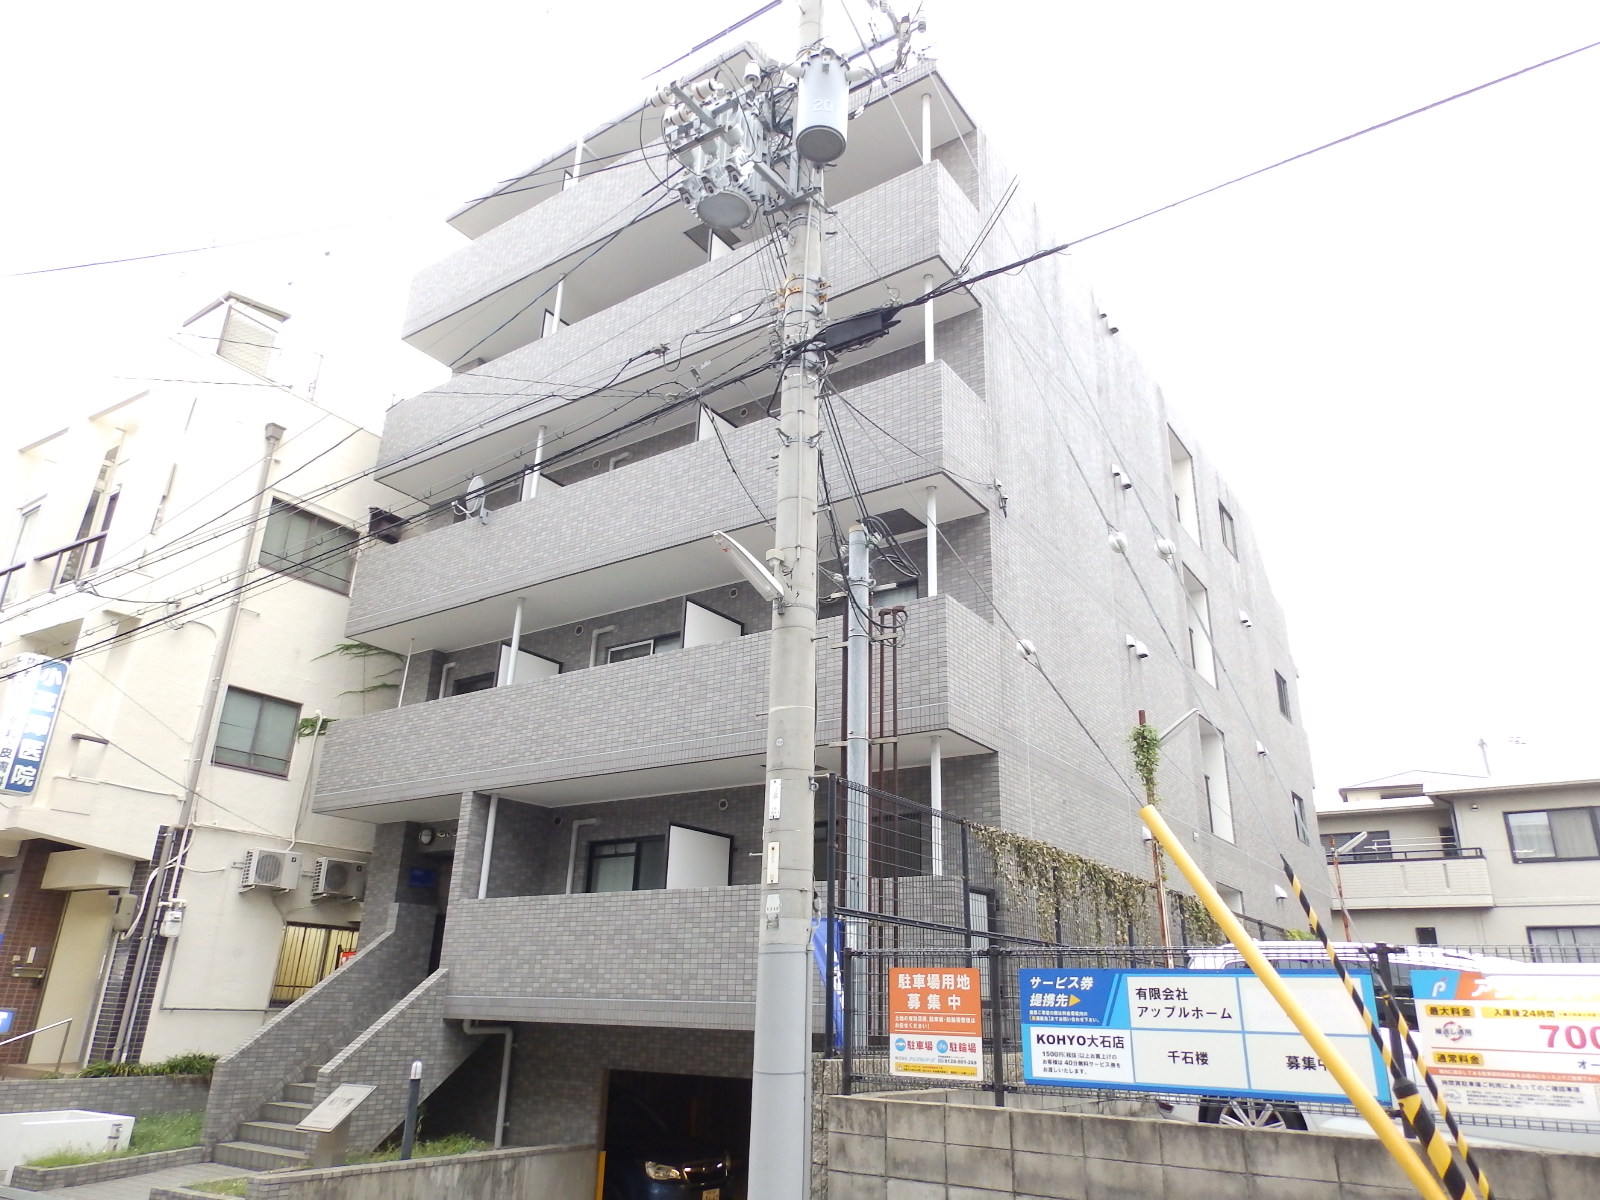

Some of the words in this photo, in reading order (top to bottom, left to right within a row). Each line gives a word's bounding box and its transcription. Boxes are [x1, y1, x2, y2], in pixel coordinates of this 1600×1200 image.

[898, 973, 971, 990] 駐車場用地
[1030, 976, 1094, 990] サービス券
[1029, 993, 1068, 1007] 提携先
[1135, 987, 1189, 1001] 有限会社
[907, 993, 961, 1010] 募集中
[1137, 1005, 1232, 1019] アップルホーム
[1430, 1006, 1471, 1016] 最大料金
[907, 1040, 933, 1052] 駐車場
[949, 1042, 977, 1054] 駐輪場
[1036, 1034, 1125, 1049] KOHYO大石店
[1167, 1050, 1209, 1066] 千石楼
[1437, 1053, 1480, 1065] 通常料金
